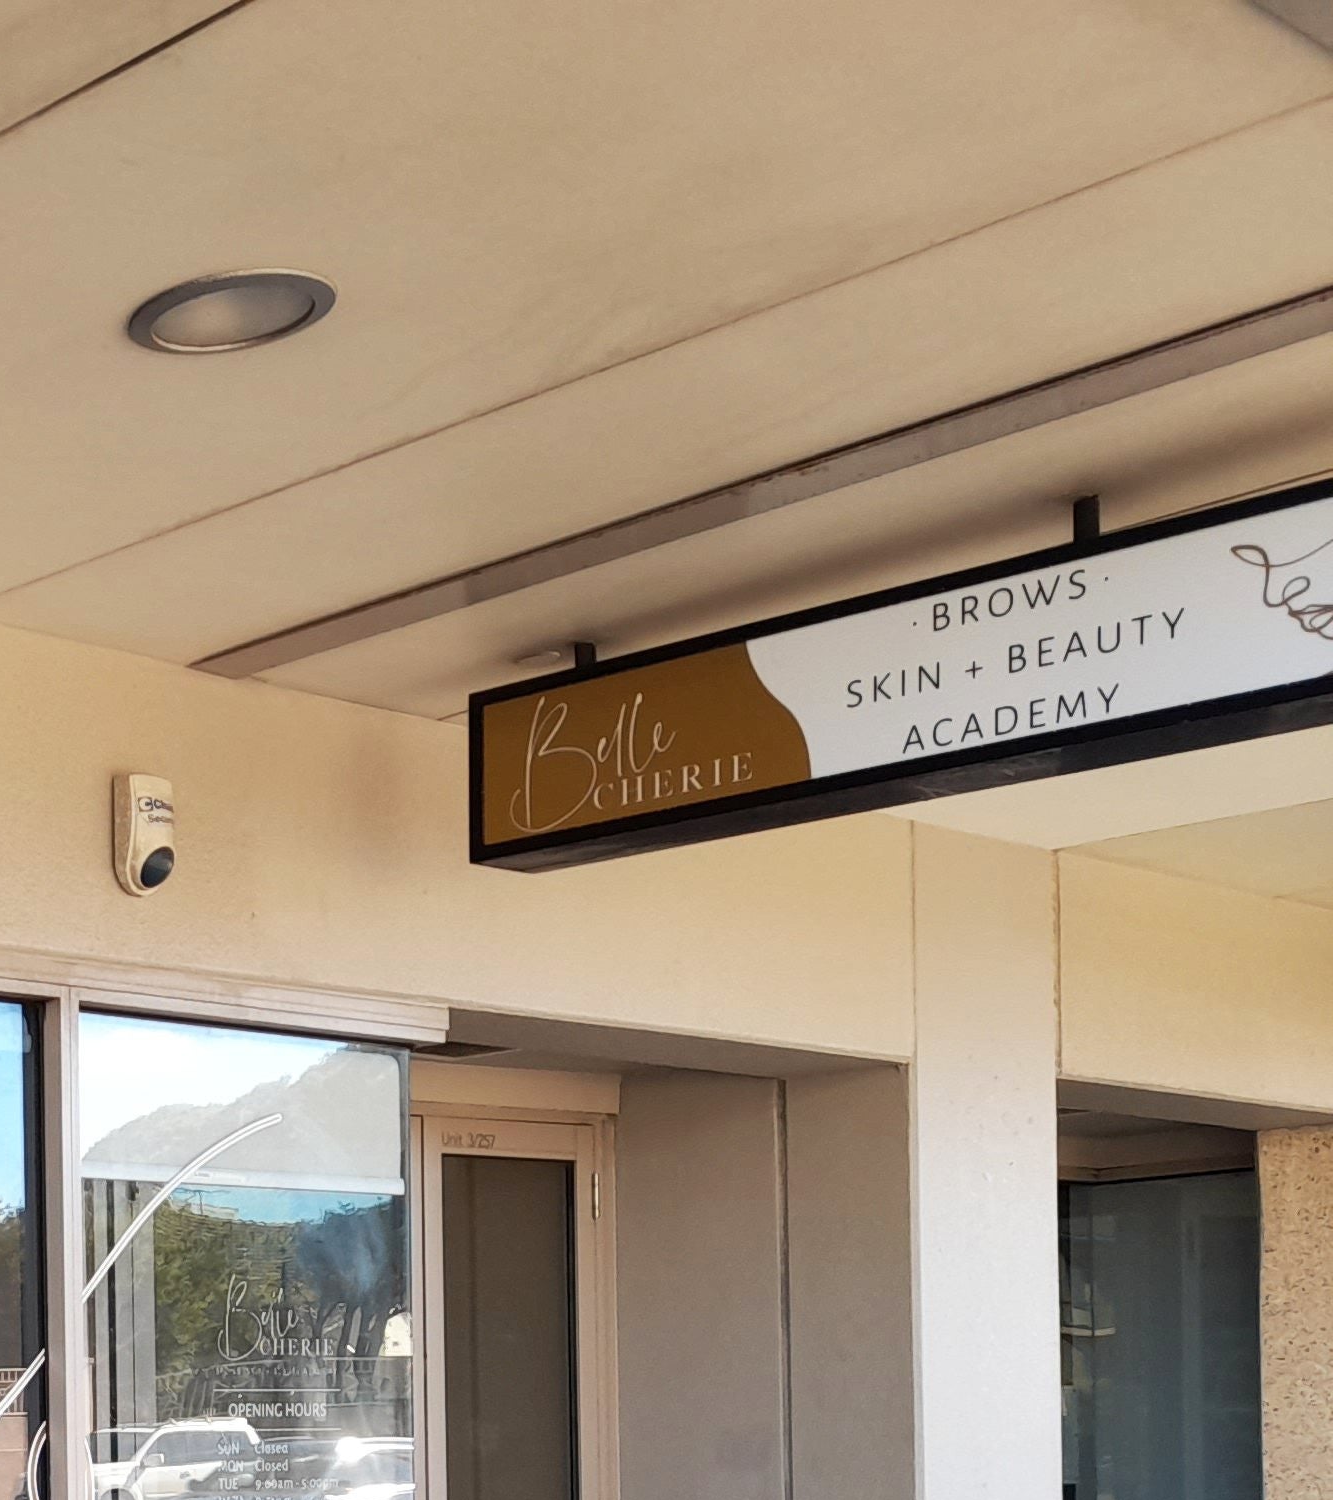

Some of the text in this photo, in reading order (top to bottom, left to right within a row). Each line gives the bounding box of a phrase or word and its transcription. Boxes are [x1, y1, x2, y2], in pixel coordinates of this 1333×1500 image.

[932, 569, 1086, 631] BROWS
[846, 662, 940, 708] SKIN
[1008, 607, 1184, 673] BEAUTY
[902, 683, 1119, 754] ACADEMY
[510, 692, 677, 832] Belle
[593, 752, 754, 810] CHERIE
[228, 1402, 327, 1417] OPENING HOURS
[218, 1478, 239, 1490] TUE
[255, 1459, 289, 1472] Closed
